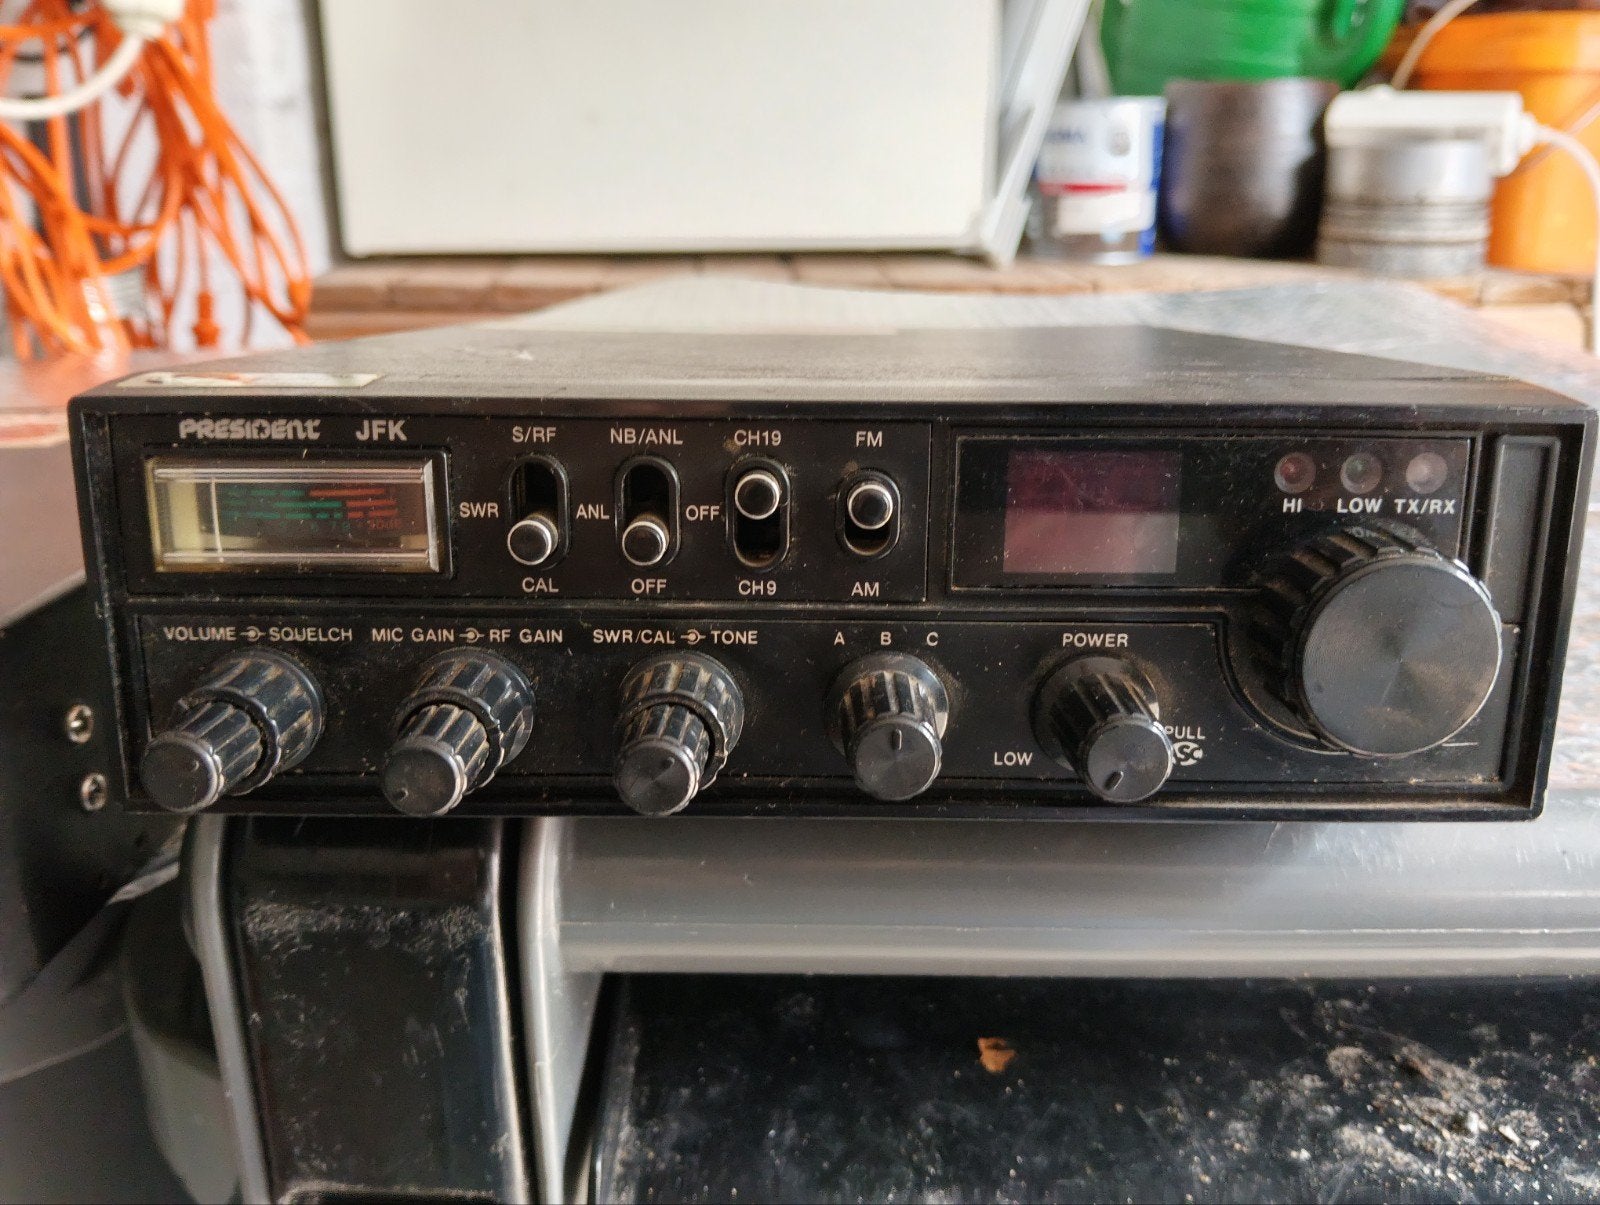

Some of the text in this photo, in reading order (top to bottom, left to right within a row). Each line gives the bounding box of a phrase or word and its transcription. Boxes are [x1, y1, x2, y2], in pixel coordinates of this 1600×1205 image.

[178, 417, 408, 442] PRESIDENT JFK
[511, 425, 557, 443] S/RF
[610, 427, 684, 446] NB/ANL
[733, 429, 782, 448] CH19
[855, 430, 883, 448] FM
[459, 501, 499, 519] SWR
[575, 503, 610, 520] ANL
[685, 504, 720, 522] OFF
[1282, 497, 1303, 513] HI
[1336, 496, 1383, 514] LOW
[1393, 498, 1457, 515] TX/RX
[521, 576, 560, 593] CAL
[630, 577, 667, 595] OFF
[850, 581, 880, 598] AM
[162, 625, 353, 642] VOLUME SQUELCH
[371, 627, 563, 644] MIC GAIN RF GAIN
[592, 628, 758, 645] SWR/CAL TONE
[833, 631, 939, 647] A B C
[1062, 632, 1129, 648] POWER
[993, 751, 1033, 767] LOW
